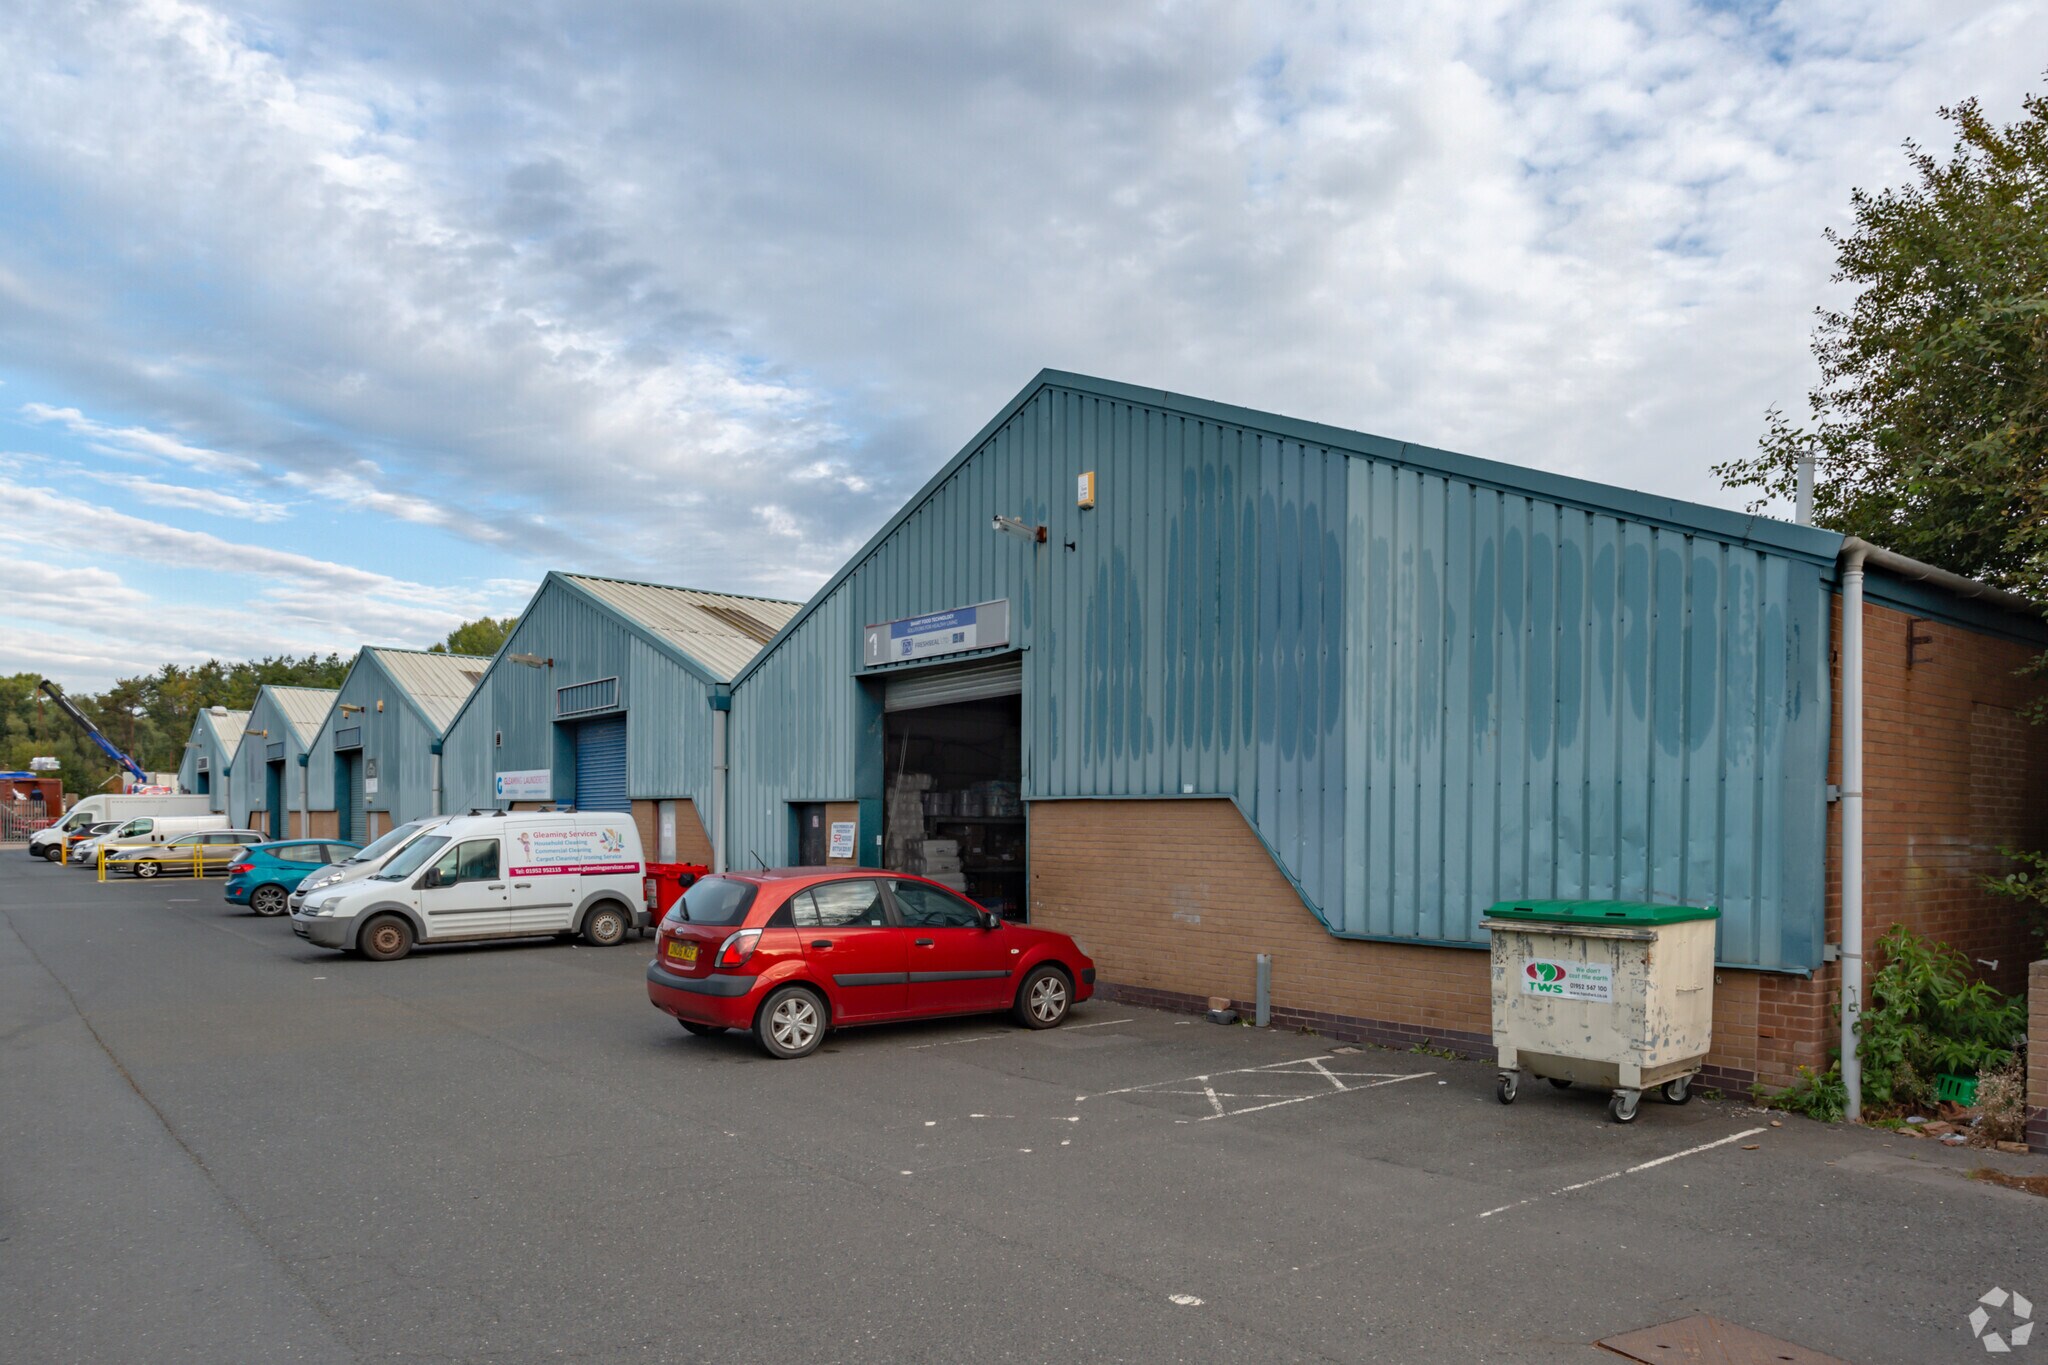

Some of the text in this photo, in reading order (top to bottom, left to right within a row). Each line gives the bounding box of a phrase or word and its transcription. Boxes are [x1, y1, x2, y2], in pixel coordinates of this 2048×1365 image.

[869, 632, 878, 656] 1
[533, 830, 598, 839] Gleaming Services
[568, 864, 635, 872] www.gleamingservices.com
[1529, 982, 1563, 993] TWS
